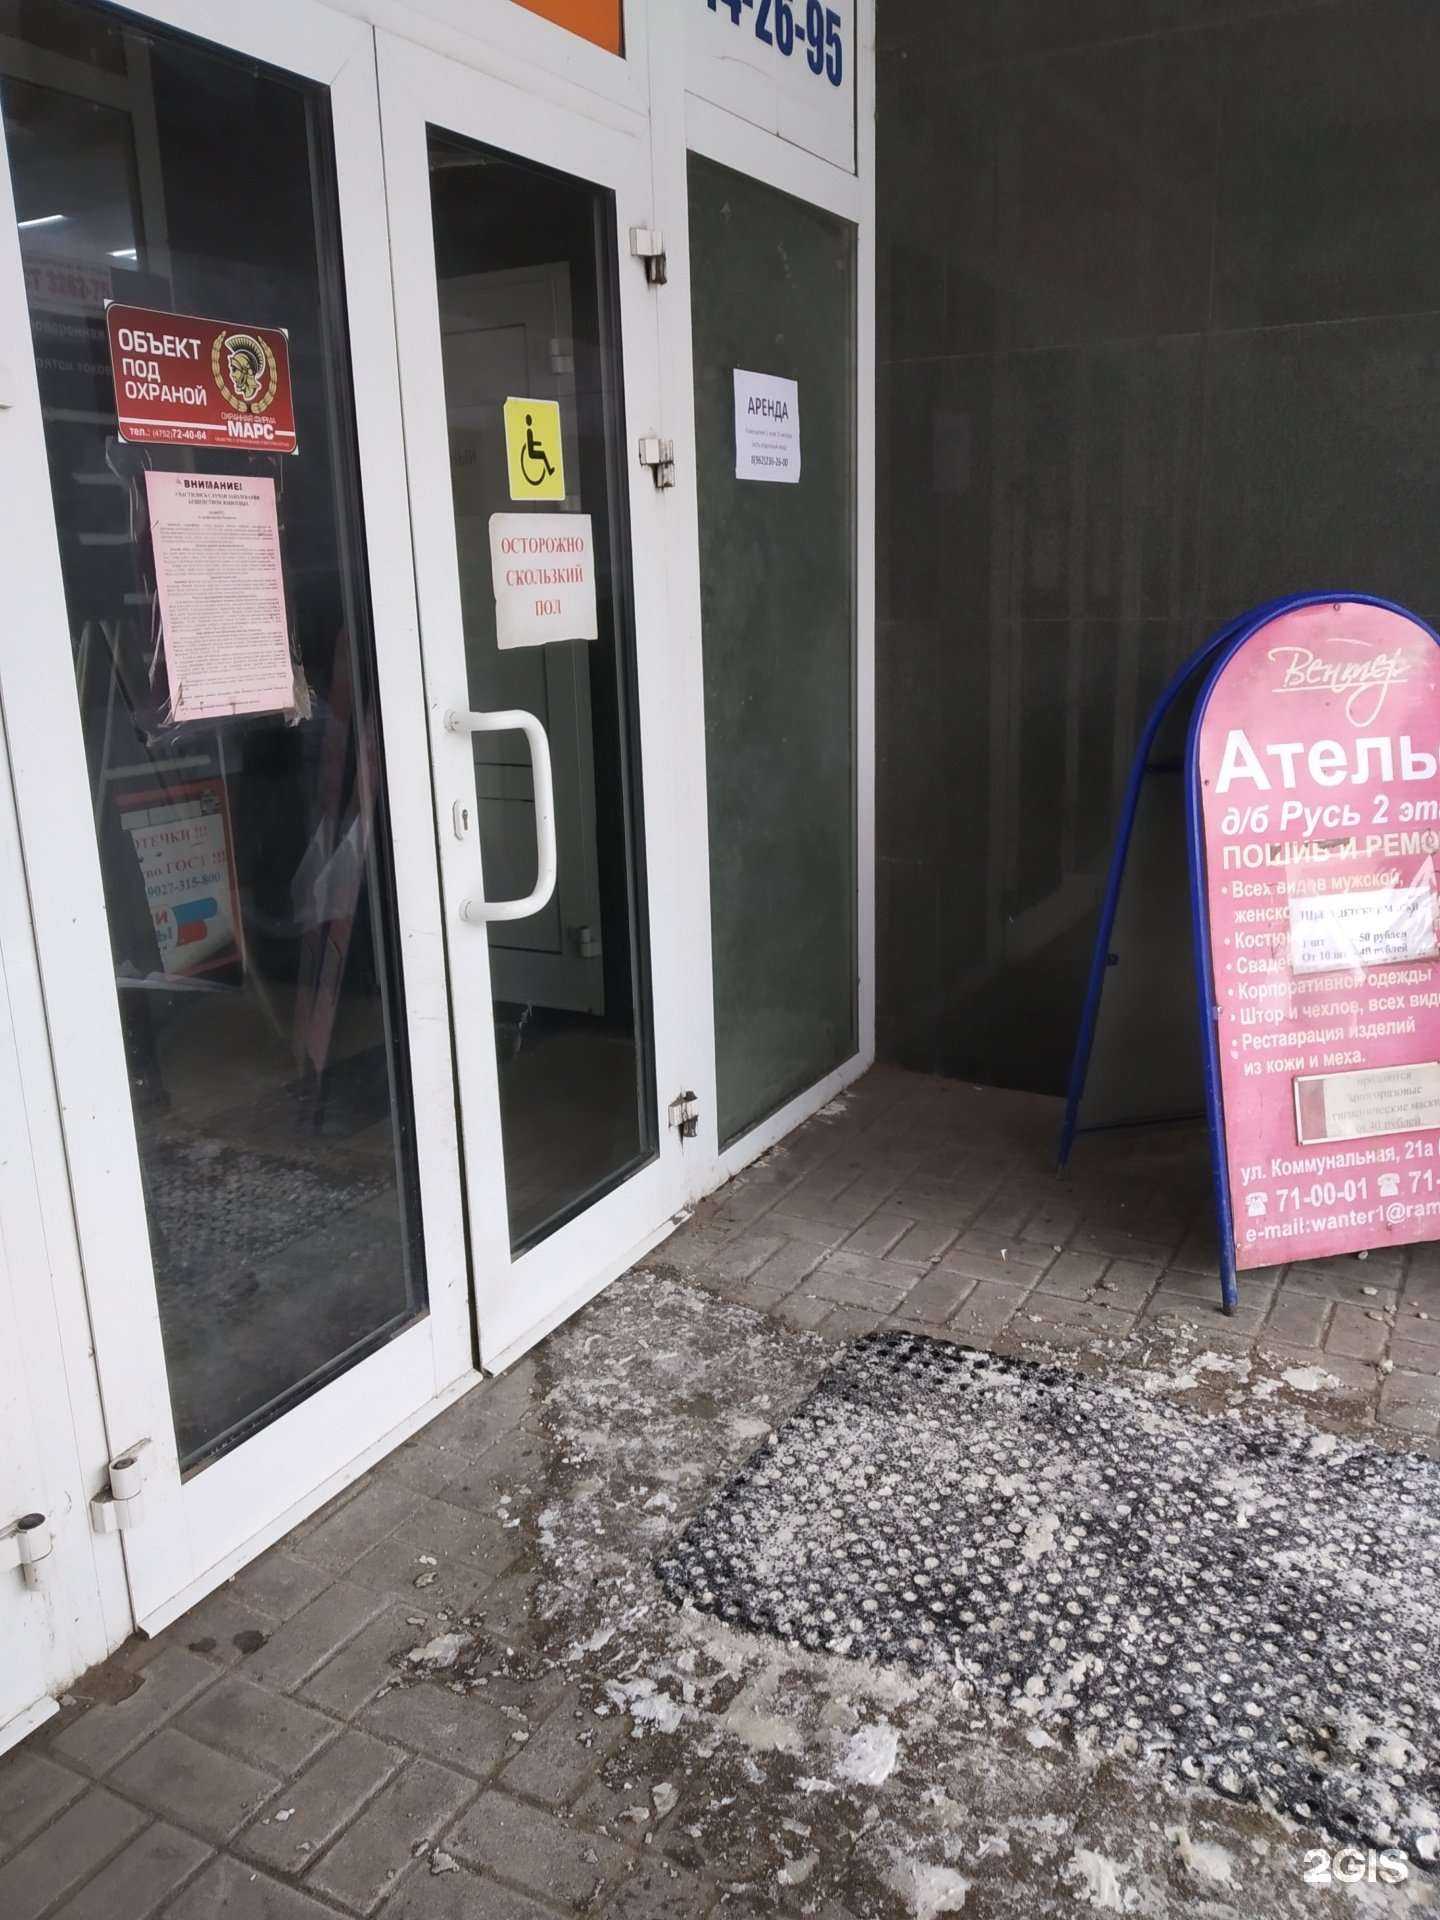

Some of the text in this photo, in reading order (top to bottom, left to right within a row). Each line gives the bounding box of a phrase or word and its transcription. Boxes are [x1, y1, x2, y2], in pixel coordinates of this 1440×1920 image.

[707, 0, 843, 87] -26-95
[118, 328, 201, 360] ОБЪЕКТ
[122, 358, 161, 383] ПОД
[125, 380, 208, 406] ОХРАНОЙ
[748, 396, 789, 422] АРЕНДА
[227, 420, 275, 440] МАРС
[184, 479, 242, 491] ВНИМАНИЕ!
[501, 536, 584, 554] ОСТОРОЖНО
[506, 564, 584, 587] СКОЛЬЗКИЙ
[535, 599, 562, 616] ПОЛ
[1215, 729, 1440, 793] Атель
[1279, 800, 1361, 838] Русь
[1371, 794, 1390, 825] 2
[1398, 800, 1440, 823] эт
[1223, 838, 1330, 870] ПОШИВ
[1339, 837, 1358, 861] И
[1232, 881, 1272, 899] Всех
[1276, 877, 1327, 897] видов
[1234, 906, 1291, 923] женско
[1235, 930, 1291, 949] Костю
[1236, 955, 1292, 975] Сваде
[1238, 969, 1432, 1003] Корпоративной одежды
[1240, 992, 1440, 1027] Штор и чехлов, всех вид
[1242, 1016, 1416, 1050] Реставрация изделий
[1244, 1050, 1366, 1076] из кожи и меха.
[1240, 1139, 1434, 1186] ул. Коммунальная, 21а
[1276, 1176, 1368, 1213] 71-00-01
